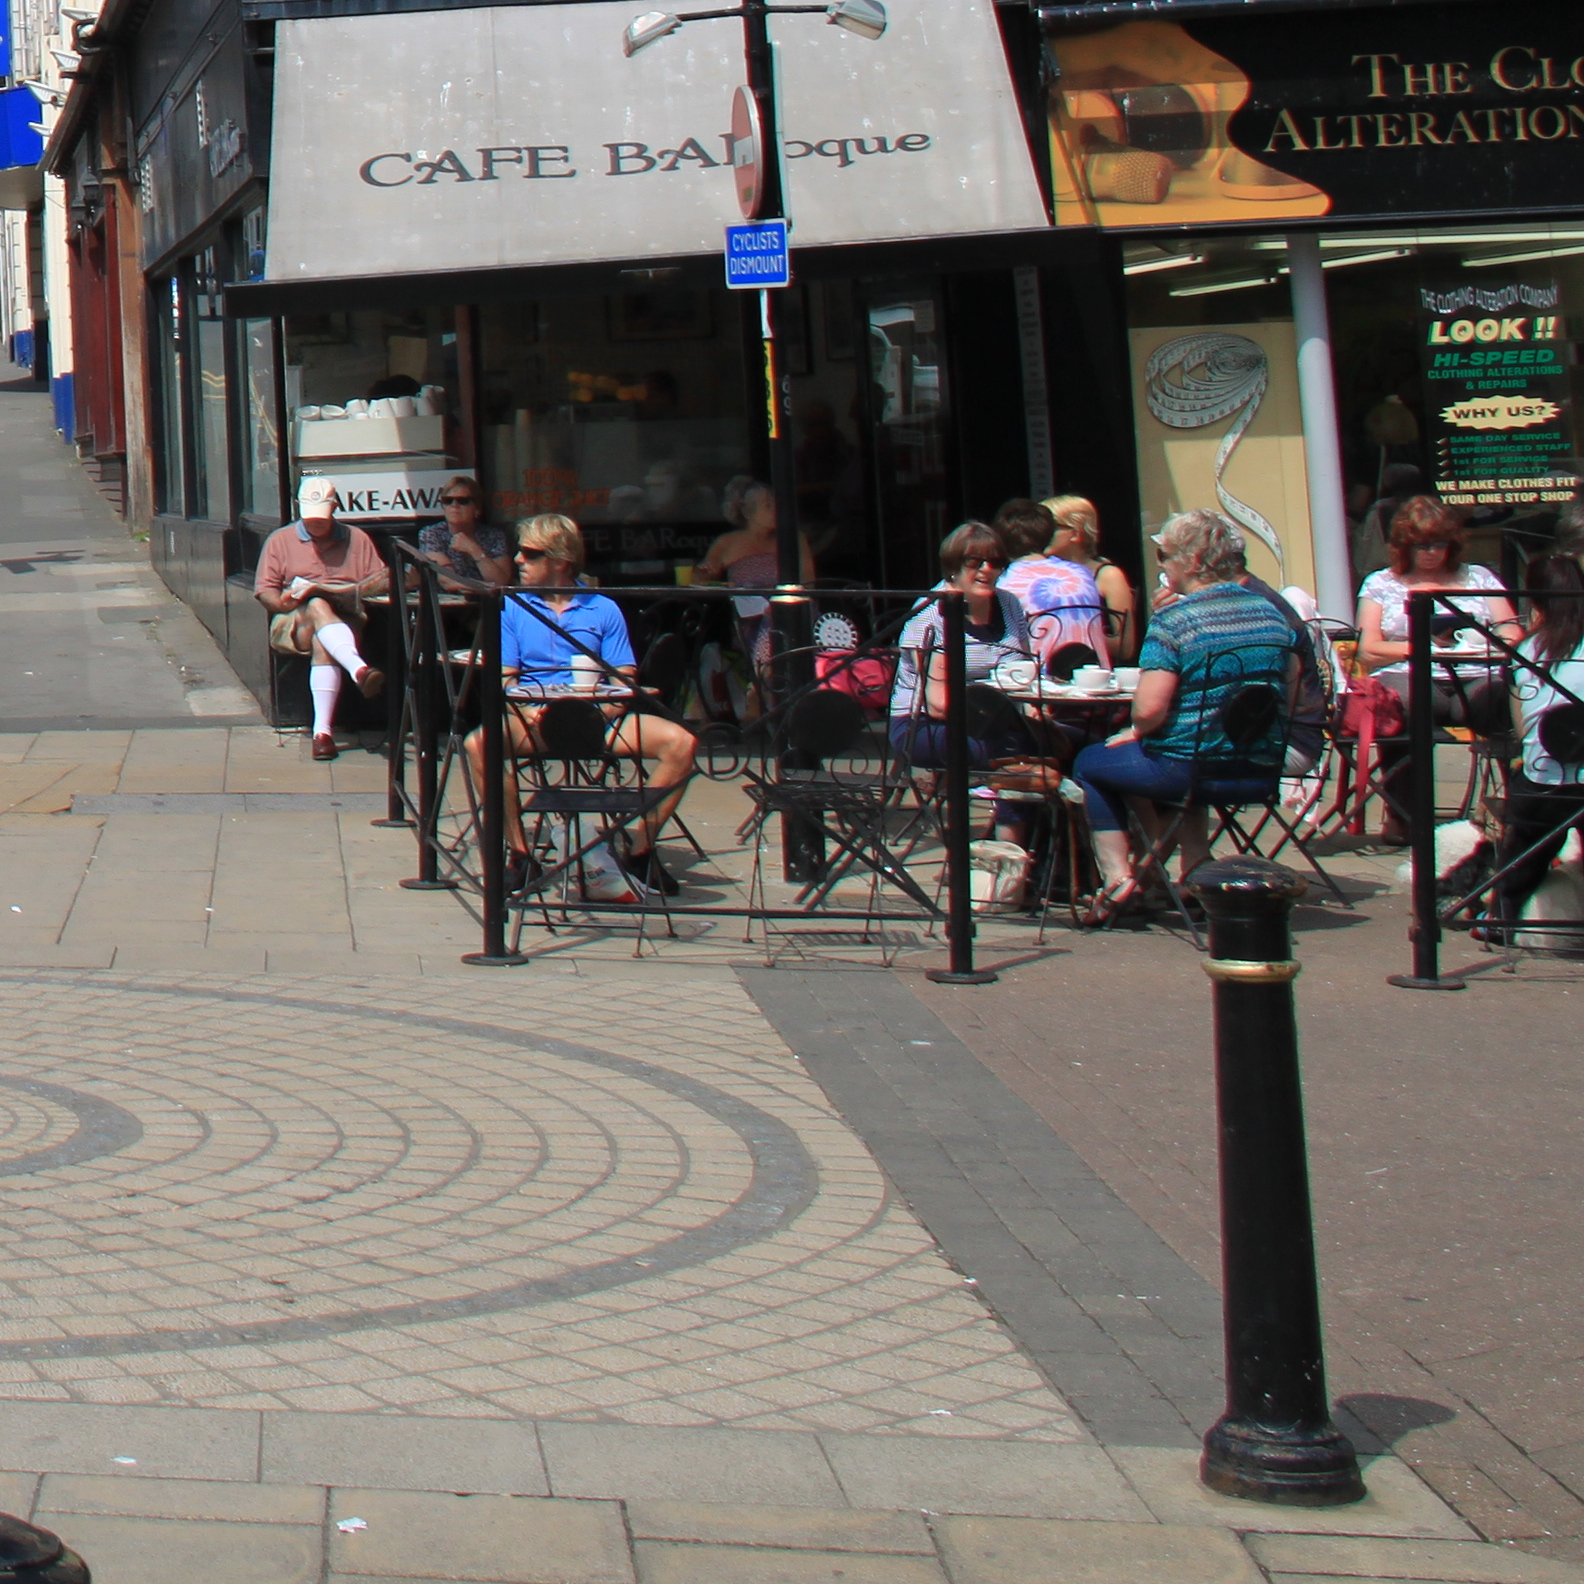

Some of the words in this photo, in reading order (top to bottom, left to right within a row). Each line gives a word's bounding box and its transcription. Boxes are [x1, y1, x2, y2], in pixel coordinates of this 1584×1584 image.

[358, 145, 577, 188] CAFE
[732, 231, 779, 252] CYCLISTS
[731, 254, 784, 275] DISMOUNT
[1421, 288, 1436, 313] THE
[1437, 286, 1473, 314] CLOTHING
[1475, 284, 1518, 312] ALTERATION
[1519, 284, 1558, 308] COMPANY
[1428, 317, 1527, 345] LOOK
[1532, 316, 1556, 341] !!
[1434, 349, 1554, 366] HI-SPEED
[1428, 368, 1484, 379] CLOTHING
[1487, 366, 1563, 377] ALTERATIONS
[1466, 381, 1474, 390] &
[1478, 379, 1527, 389] REPAIRS
[1452, 408, 1499, 419] WHY
[1507, 405, 1546, 417] US?
[1450, 435, 1482, 444] SAME
[1485, 434, 1508, 442] DAY
[1511, 432, 1561, 441] SERVICE
[1451, 445, 1532, 454] EXPERIENCED
[1536, 443, 1572, 451] STAFF
[1499, 455, 1549, 463] SERVICE
[1500, 466, 1549, 474] QUALITY
[523, 469, 579, 488] 100%
[1435, 481, 1457, 492] WE
[1459, 479, 1495, 491] MAKE
[1498, 478, 1553, 489] CLOTHES
[1556, 476, 1577, 487] FIT
[494, 489, 563, 507] ORANGE
[1440, 494, 1474, 505] YOUR
[1477, 493, 1502, 503] ONE
[1504, 492, 1539, 503] STOP
[1540, 491, 1576, 502] SHOP
